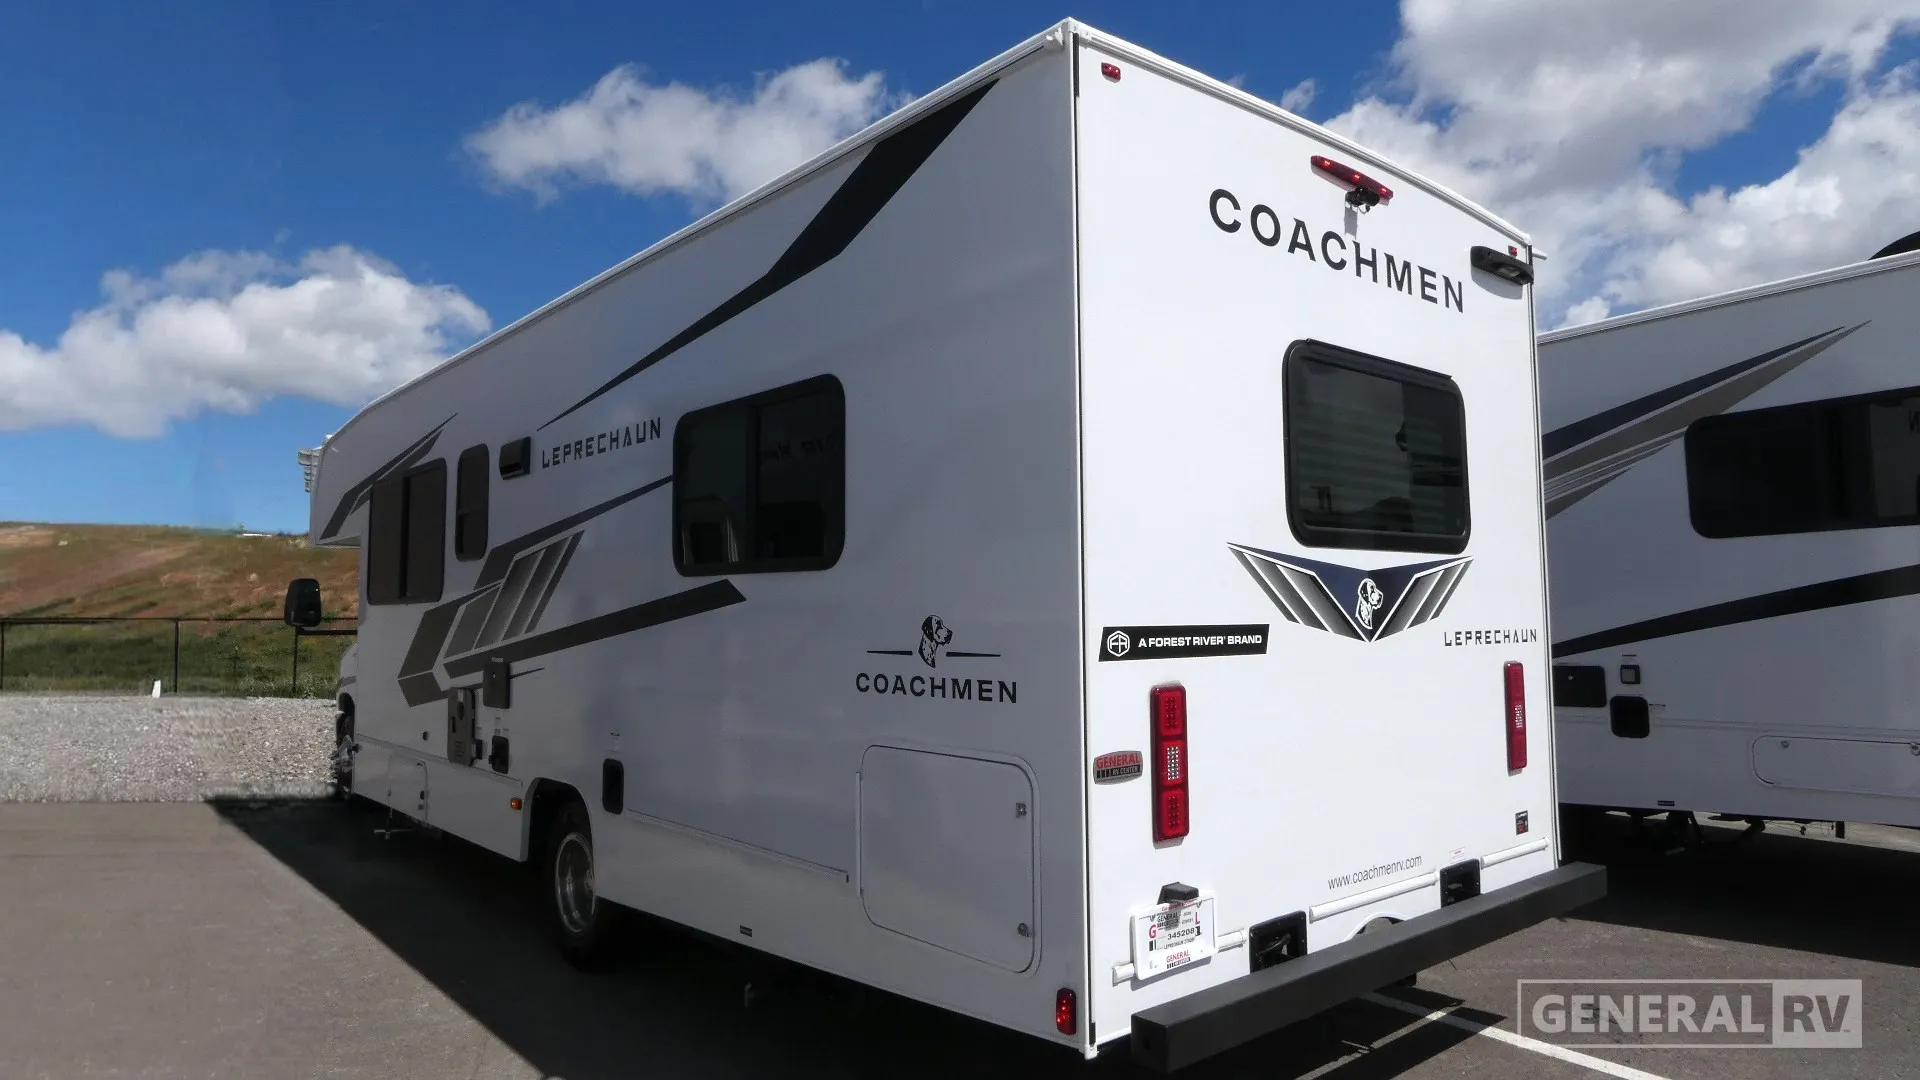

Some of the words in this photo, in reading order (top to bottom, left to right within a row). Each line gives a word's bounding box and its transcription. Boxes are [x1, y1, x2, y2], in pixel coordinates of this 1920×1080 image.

[1208, 187, 1464, 313] COACHMEN
[542, 417, 661, 469] LEPRECHAUN
[1138, 637, 1147, 648] A
[1148, 636, 1192, 648] FOREST
[1227, 634, 1262, 645] BRAND
[1443, 628, 1537, 647] LEPRECHAUN
[855, 672, 1017, 704] COACHMEN
[1096, 752, 1141, 769] GENERAL
[1327, 855, 1423, 890] www.coachmenrv.com
[1167, 928, 1195, 940] 345208
[1166, 950, 1190, 962] GENERAL
